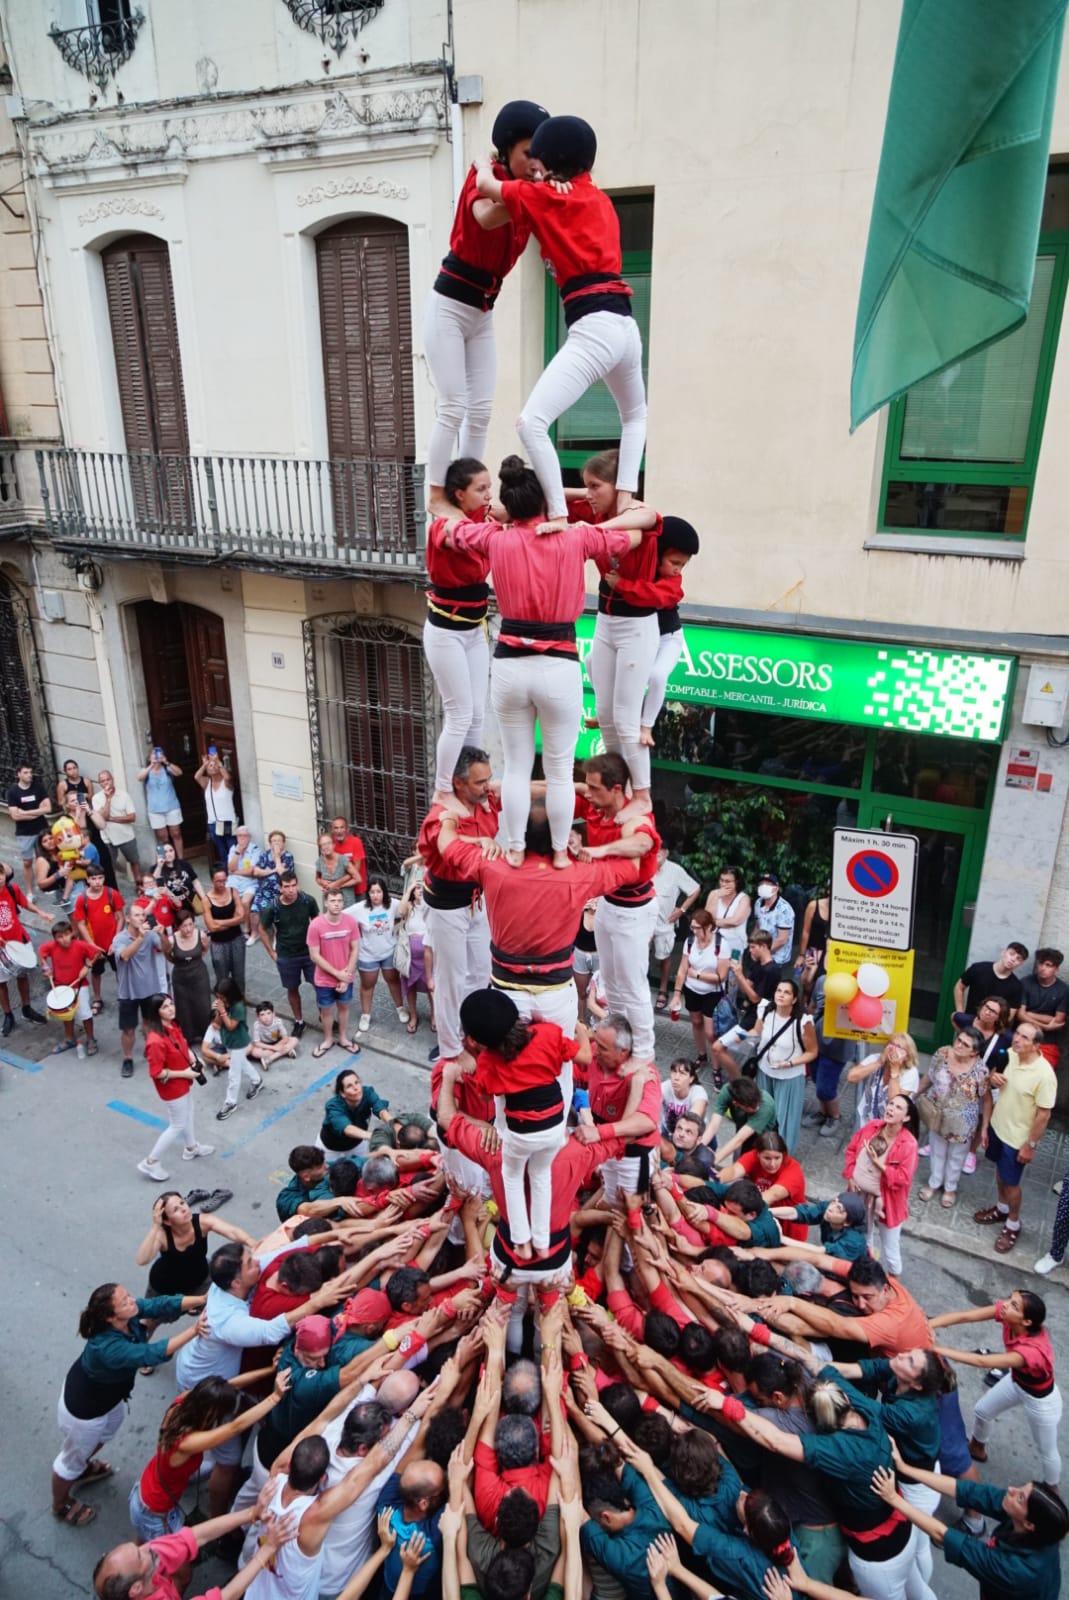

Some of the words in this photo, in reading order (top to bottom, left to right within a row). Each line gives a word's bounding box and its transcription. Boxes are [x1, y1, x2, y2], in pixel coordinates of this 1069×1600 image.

[678, 636, 833, 692] ASSESSORS
[665, 684, 718, 699] COMPTABLE
[724, 691, 776, 706] MERCANTIL
[890, 903, 909, 912] hores
[880, 909, 898, 917] hores
[878, 929, 900, 937] indicar
